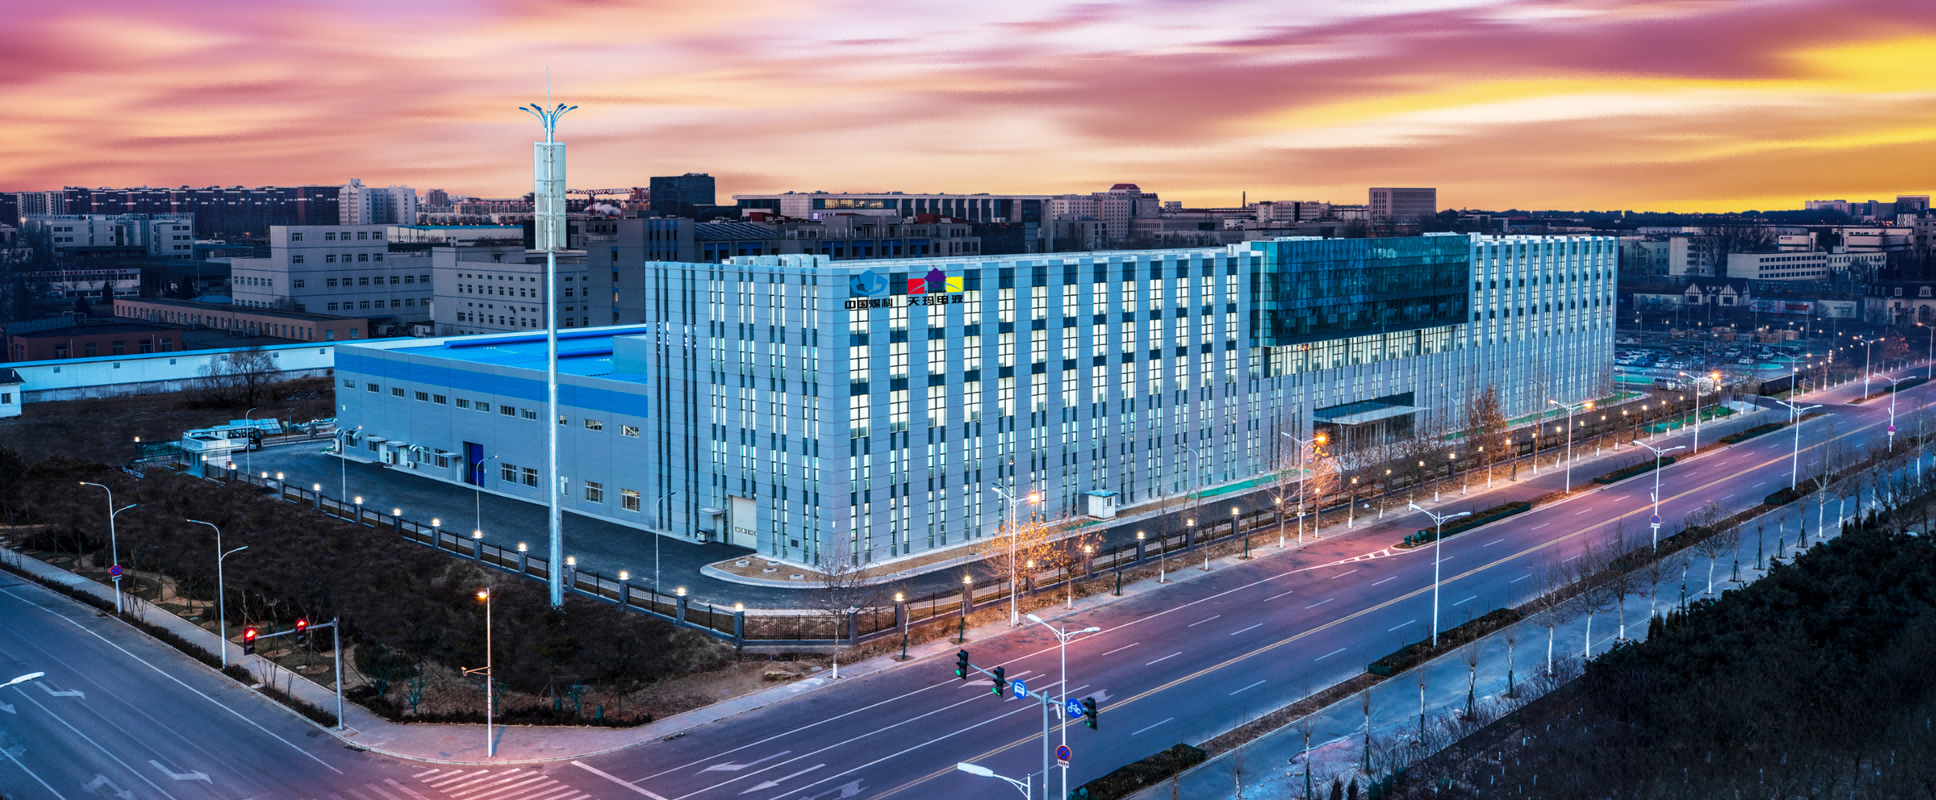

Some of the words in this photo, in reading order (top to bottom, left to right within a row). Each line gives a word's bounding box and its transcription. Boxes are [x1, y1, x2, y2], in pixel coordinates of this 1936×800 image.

[845, 298, 893, 309] 中国煤科
[908, 295, 963, 306] 天玛电液
